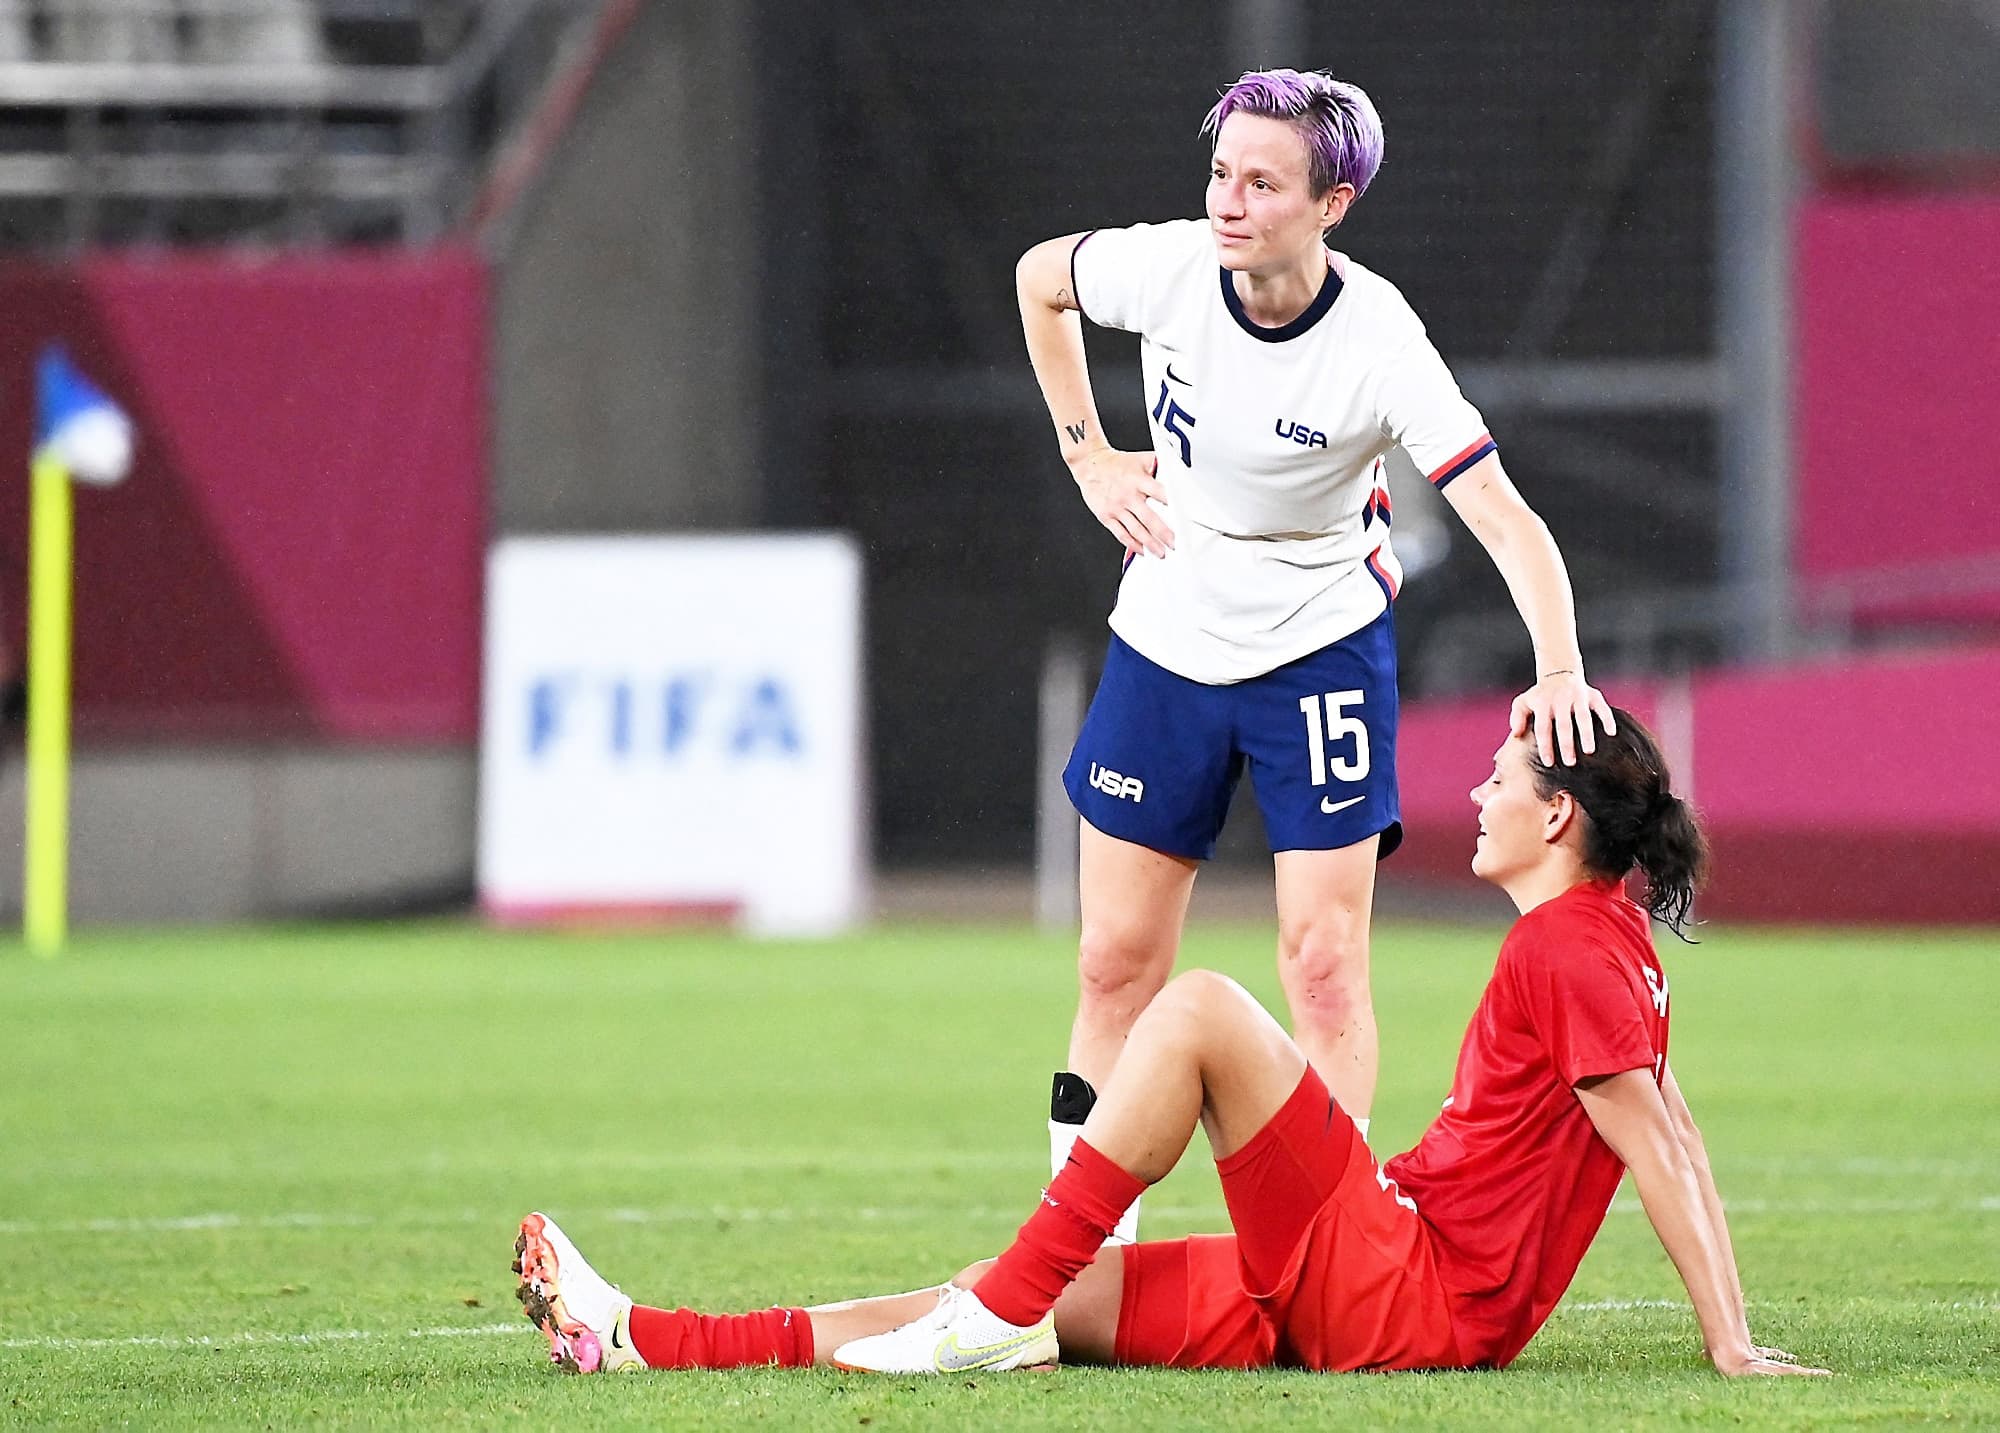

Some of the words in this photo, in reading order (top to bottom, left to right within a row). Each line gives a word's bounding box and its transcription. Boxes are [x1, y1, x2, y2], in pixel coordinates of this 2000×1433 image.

[1065, 420, 1086, 445] W
[1152, 379, 1196, 468] 15
[1275, 418, 1328, 449] USA
[524, 668, 804, 758] FIFA
[1299, 689, 1371, 786] 15
[1088, 761, 1145, 803] USA
